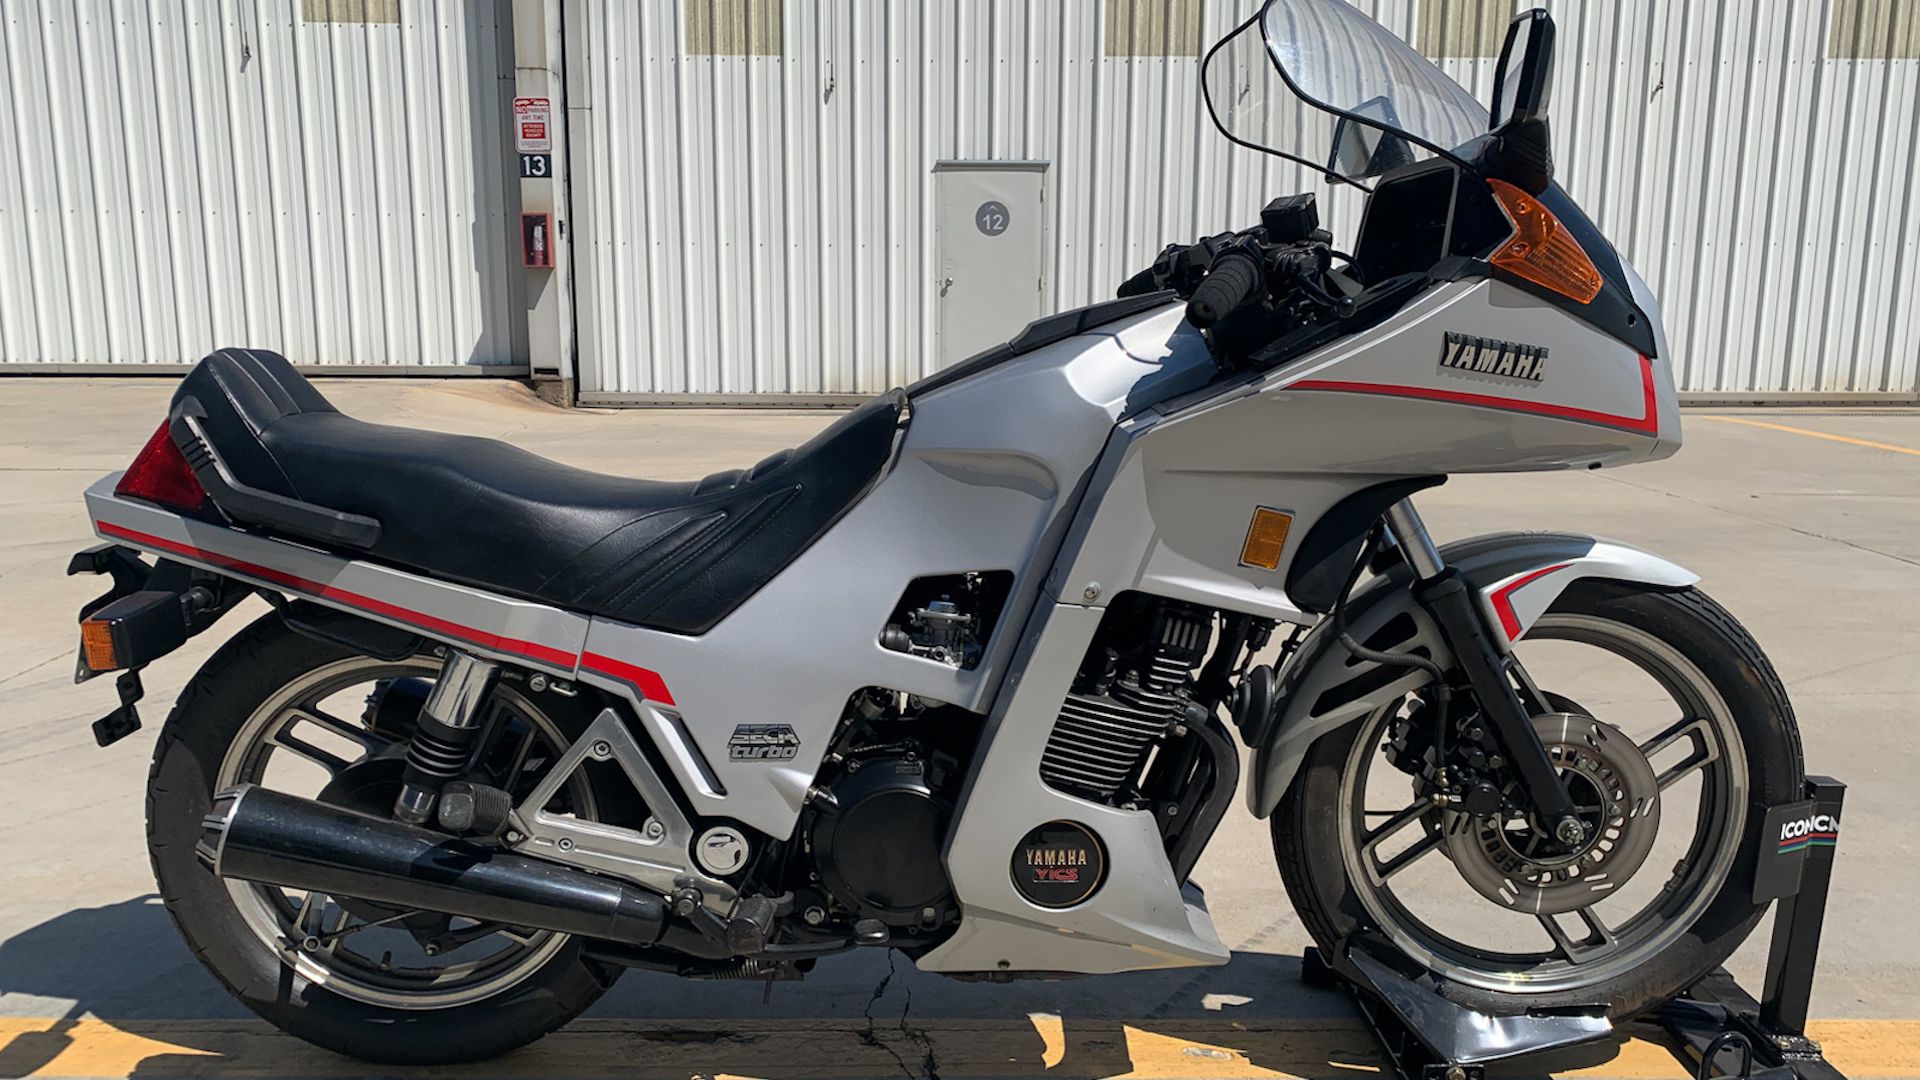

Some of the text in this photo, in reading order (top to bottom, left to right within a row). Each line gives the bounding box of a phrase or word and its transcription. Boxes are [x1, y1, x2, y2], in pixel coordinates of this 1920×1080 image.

[523, 155, 546, 176] 13
[982, 214, 1003, 230] 12
[1440, 331, 1549, 381] YAMAHA
[728, 724, 801, 744] SECA
[1026, 849, 1087, 865] YAMAHA
